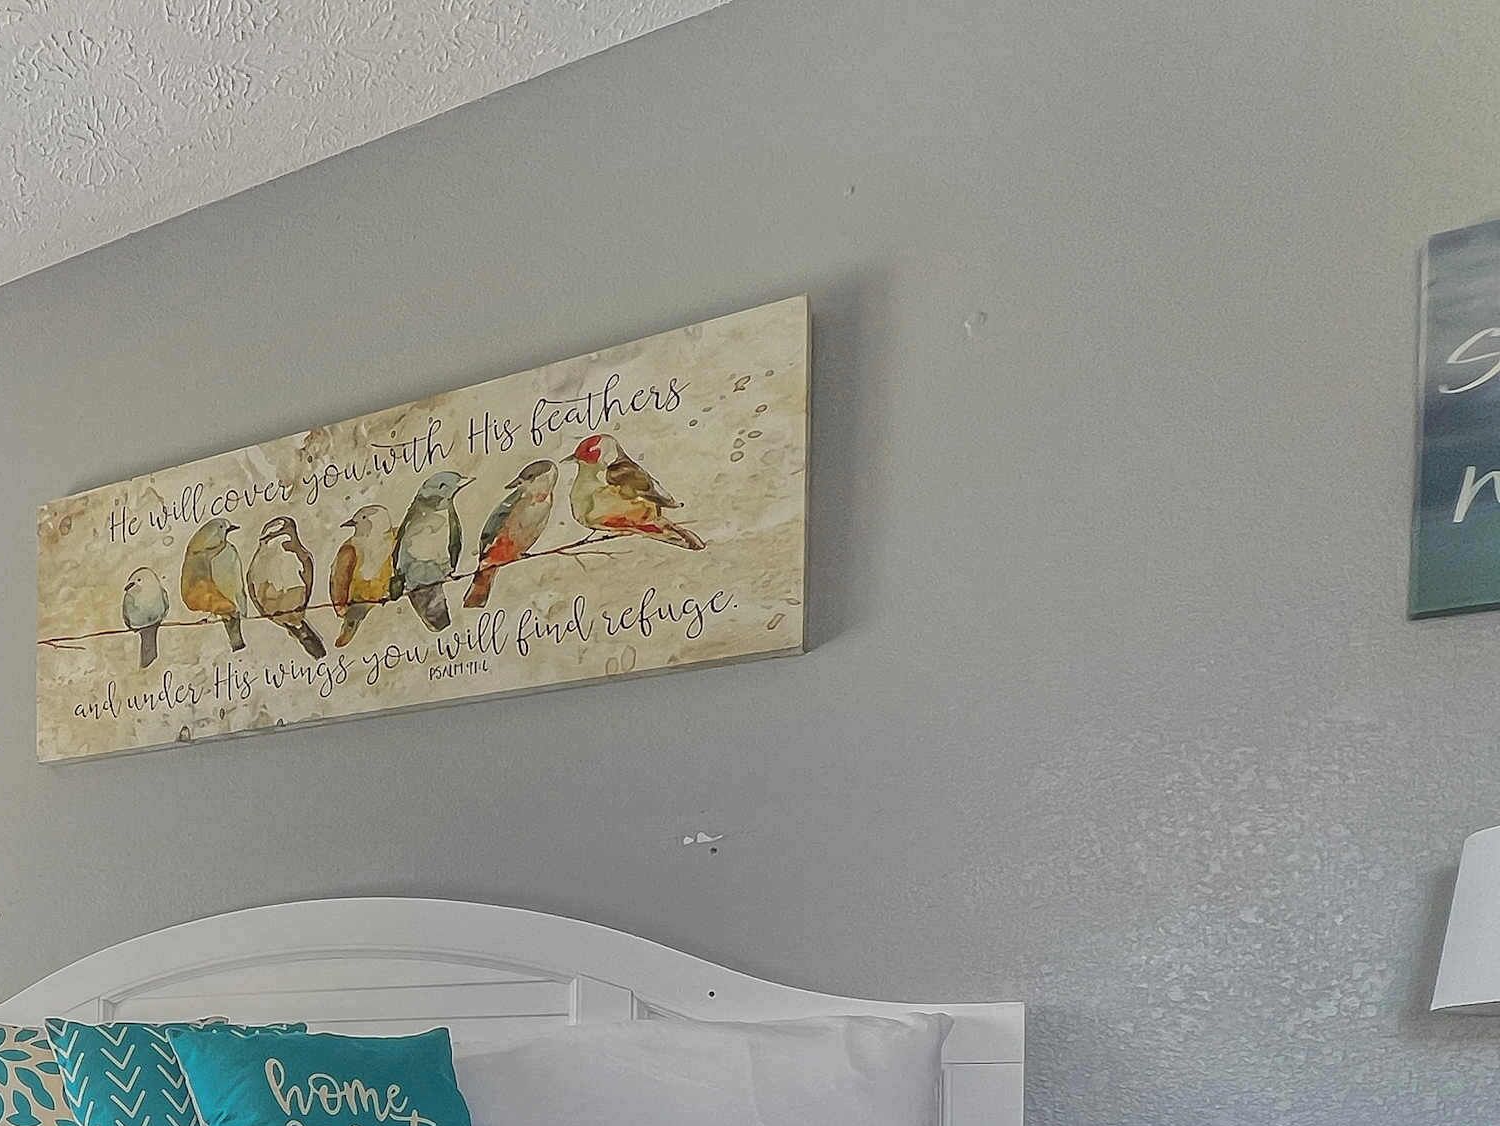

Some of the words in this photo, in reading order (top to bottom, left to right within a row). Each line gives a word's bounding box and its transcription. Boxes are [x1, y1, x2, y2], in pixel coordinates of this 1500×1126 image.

[110, 506, 142, 543] He
[150, 483, 206, 530] will
[211, 479, 292, 516] cover
[303, 461, 366, 505] you
[371, 418, 454, 475] with
[468, 411, 522, 455] His
[530, 373, 692, 447] feathers
[74, 680, 122, 720] and
[126, 669, 204, 711] under
[214, 661, 258, 701] His
[265, 653, 355, 697] wings
[361, 644, 429, 685] you
[436, 609, 508, 661] will
[516, 595, 596, 657] find
[603, 587, 739, 640] refuge.
[429, 663, 463, 681] PSALM
[264, 1057, 409, 1122] home
